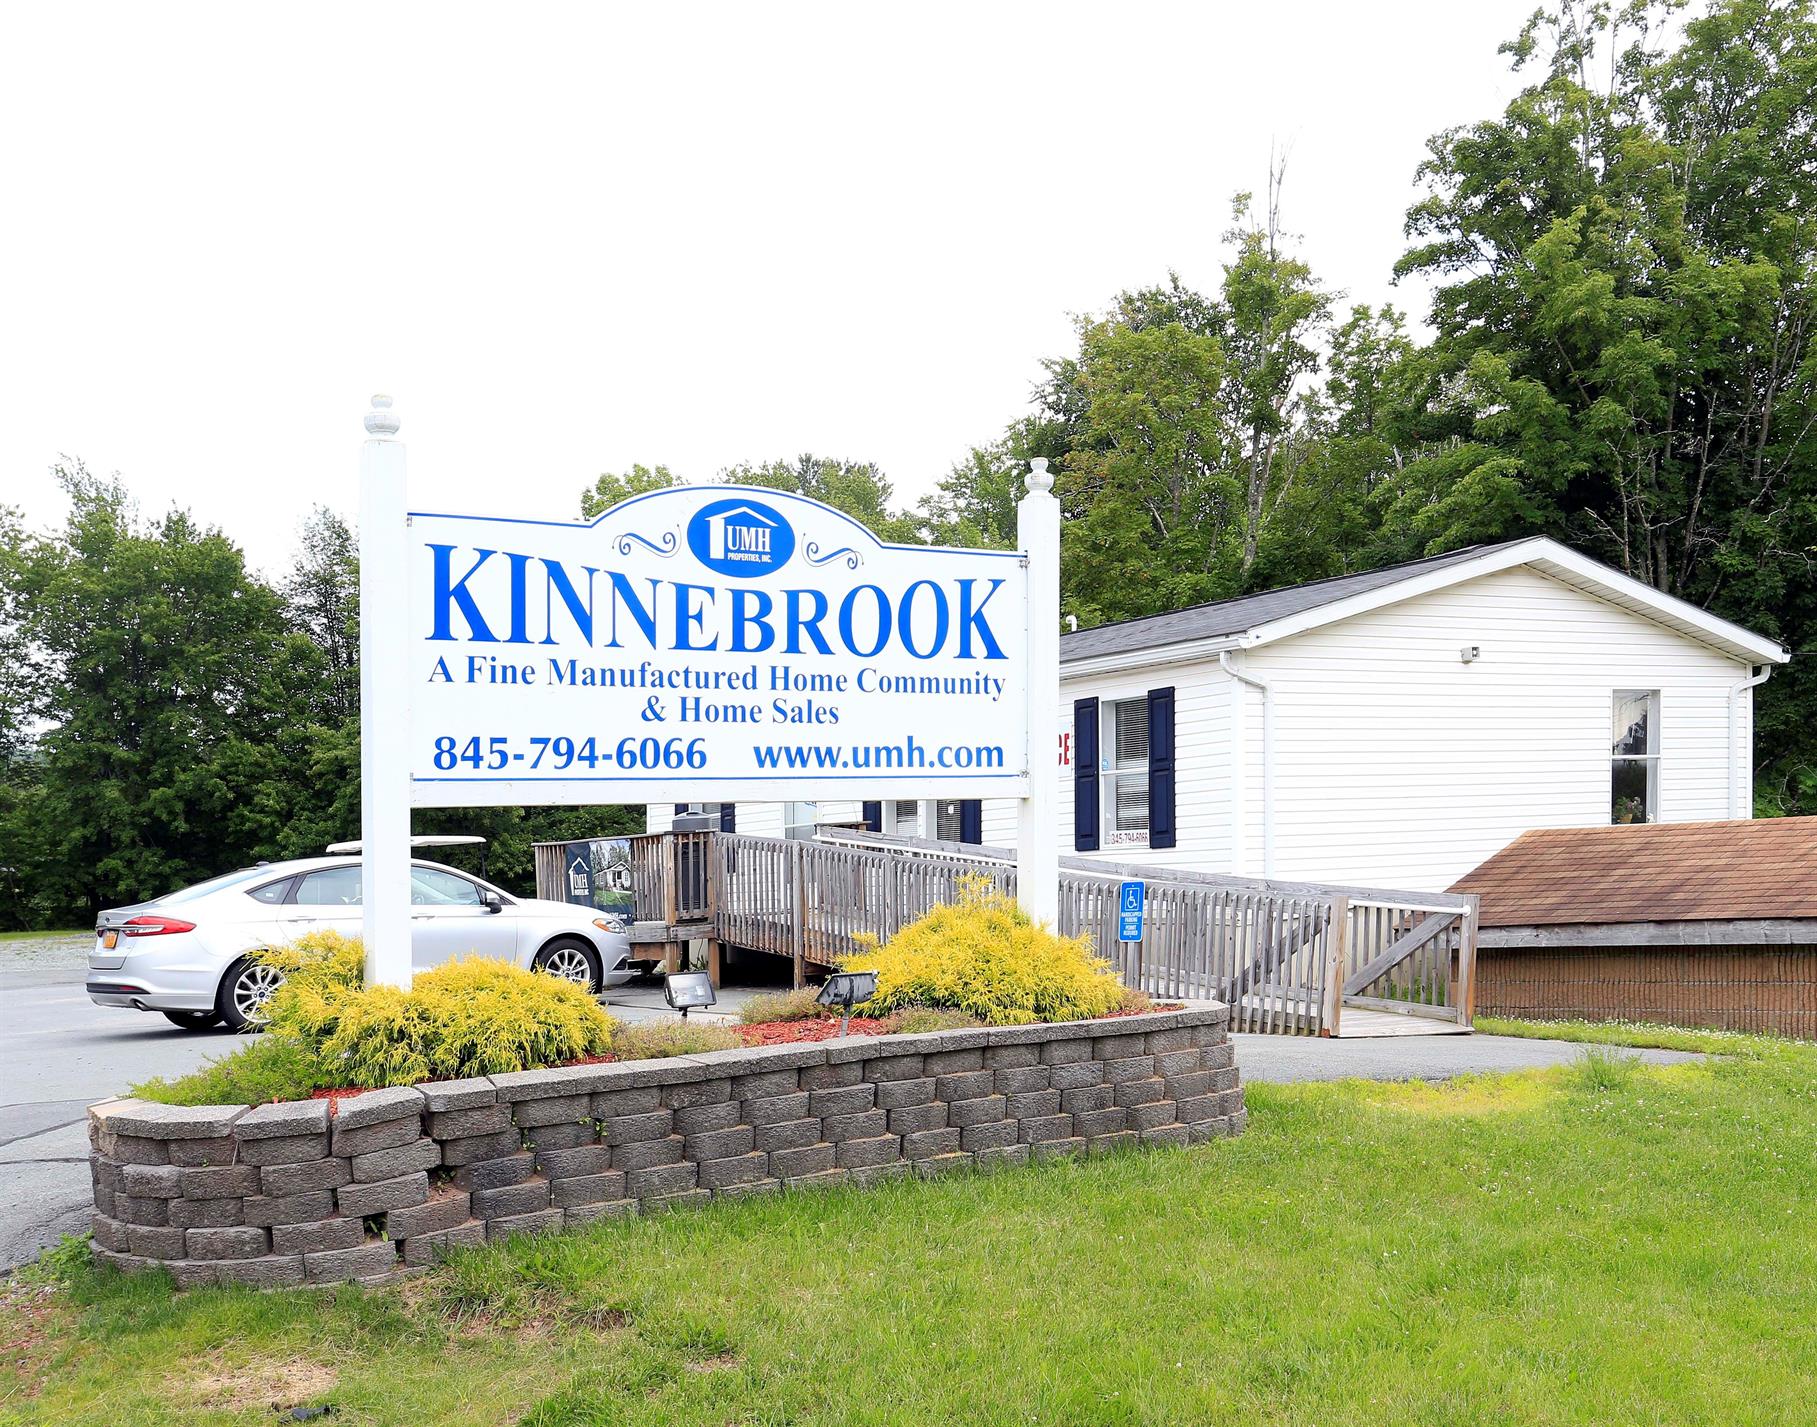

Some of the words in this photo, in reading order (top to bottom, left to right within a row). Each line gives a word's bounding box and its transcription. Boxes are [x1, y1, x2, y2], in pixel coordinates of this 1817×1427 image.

[726, 525, 771, 553] UMH
[727, 552, 760, 563] PROPERTIES,
[761, 554, 773, 563] INC.
[424, 543, 1010, 660] KINNEBROOK
[428, 655, 455, 683] A
[464, 655, 536, 685] Fine
[547, 658, 758, 690] Manufactured
[768, 665, 848, 692] Home
[856, 668, 1006, 701] Community
[641, 695, 667, 722] &
[679, 696, 763, 723] Home
[772, 697, 840, 724] Sales
[433, 736, 708, 770] 845-794-6066
[752, 735, 1004, 768] www.umh.com
